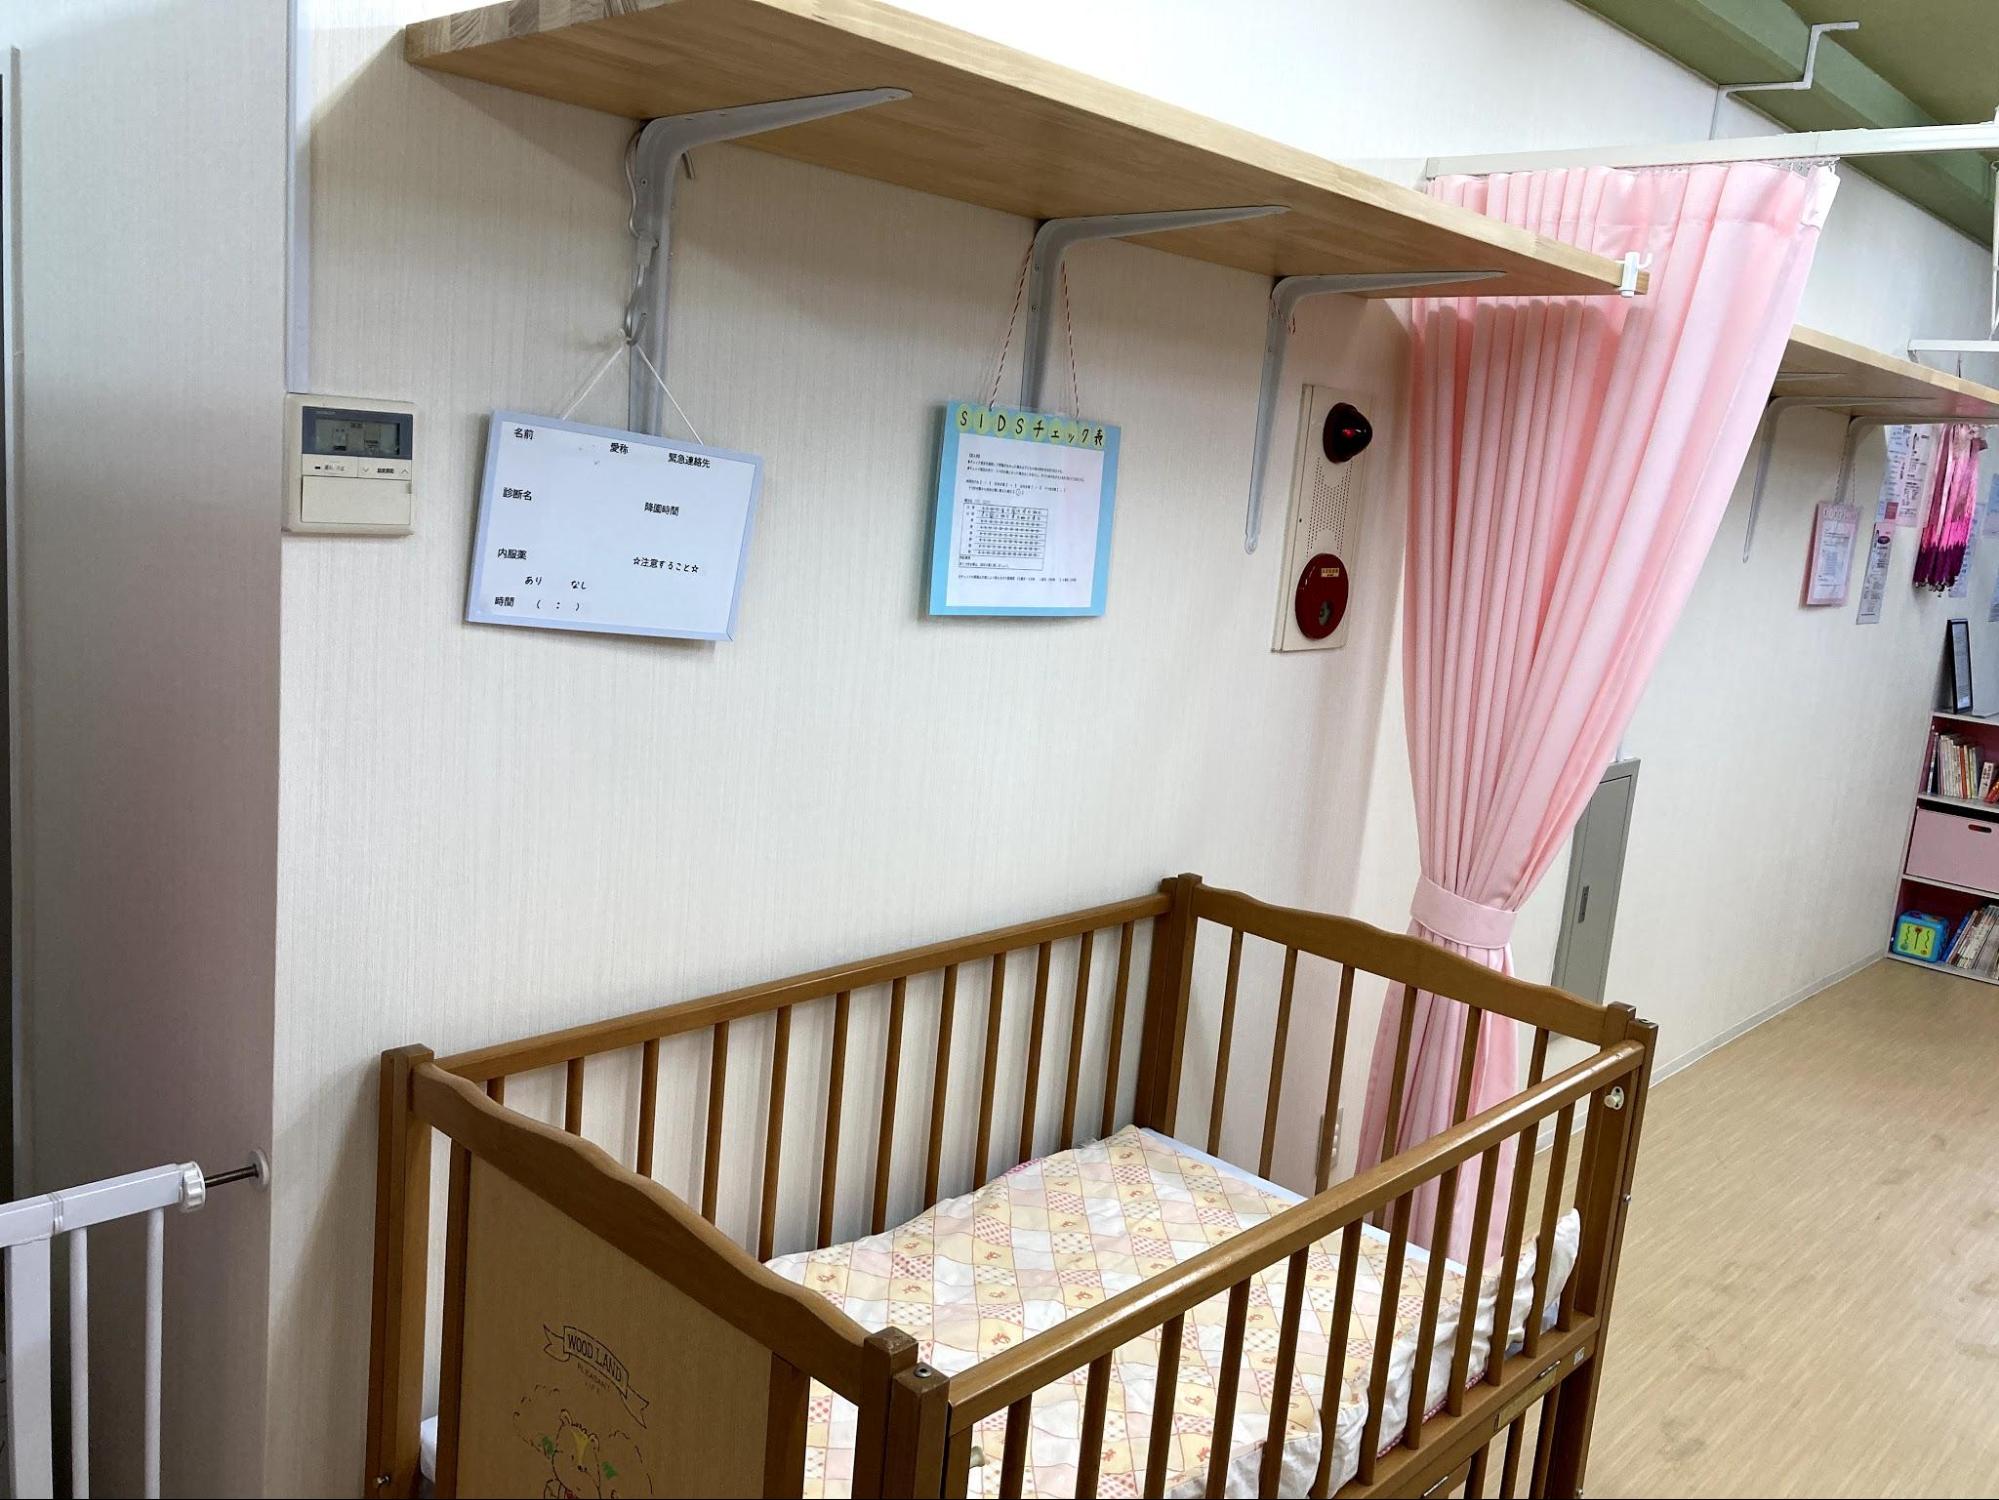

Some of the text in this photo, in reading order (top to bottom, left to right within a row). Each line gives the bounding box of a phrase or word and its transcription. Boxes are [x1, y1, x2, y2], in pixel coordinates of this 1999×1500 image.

[514, 428, 534, 440] 名前
[610, 442, 629, 454] 愛称
[668, 453, 711, 468] 緊急連絡先
[503, 487, 532, 501] 診断名
[644, 502, 679, 516] 降園時間
[498, 548, 527, 560] 内服薬
[525, 576, 587, 590] あり なし
[495, 596, 515, 607] 時間
